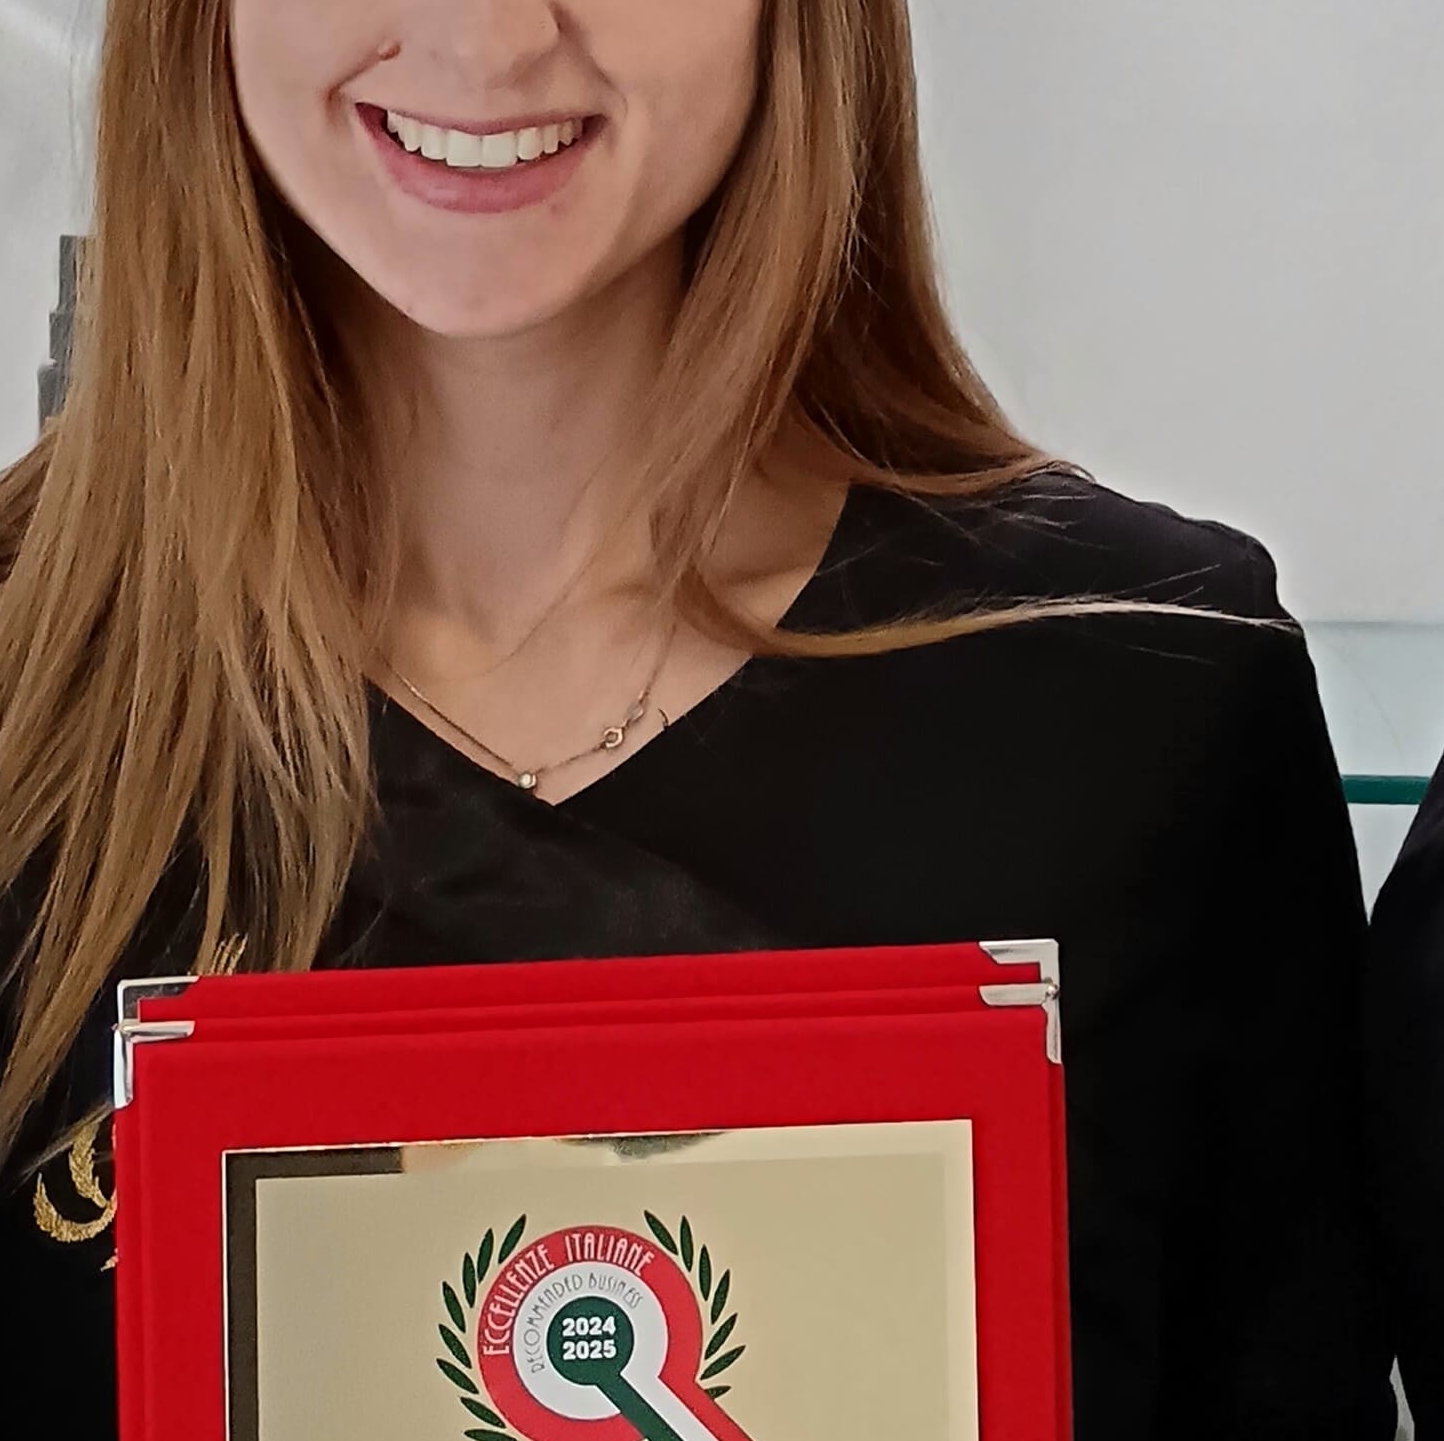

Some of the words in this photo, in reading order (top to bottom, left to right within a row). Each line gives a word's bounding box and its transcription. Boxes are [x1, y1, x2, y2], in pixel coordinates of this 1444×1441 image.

[483, 1244, 555, 1356] ECCELLENZE
[565, 1232, 655, 1277] ITALIANE
[588, 1272, 644, 1310] BUSINESS
[562, 1316, 616, 1337] 2024
[562, 1340, 617, 1361] 2025
